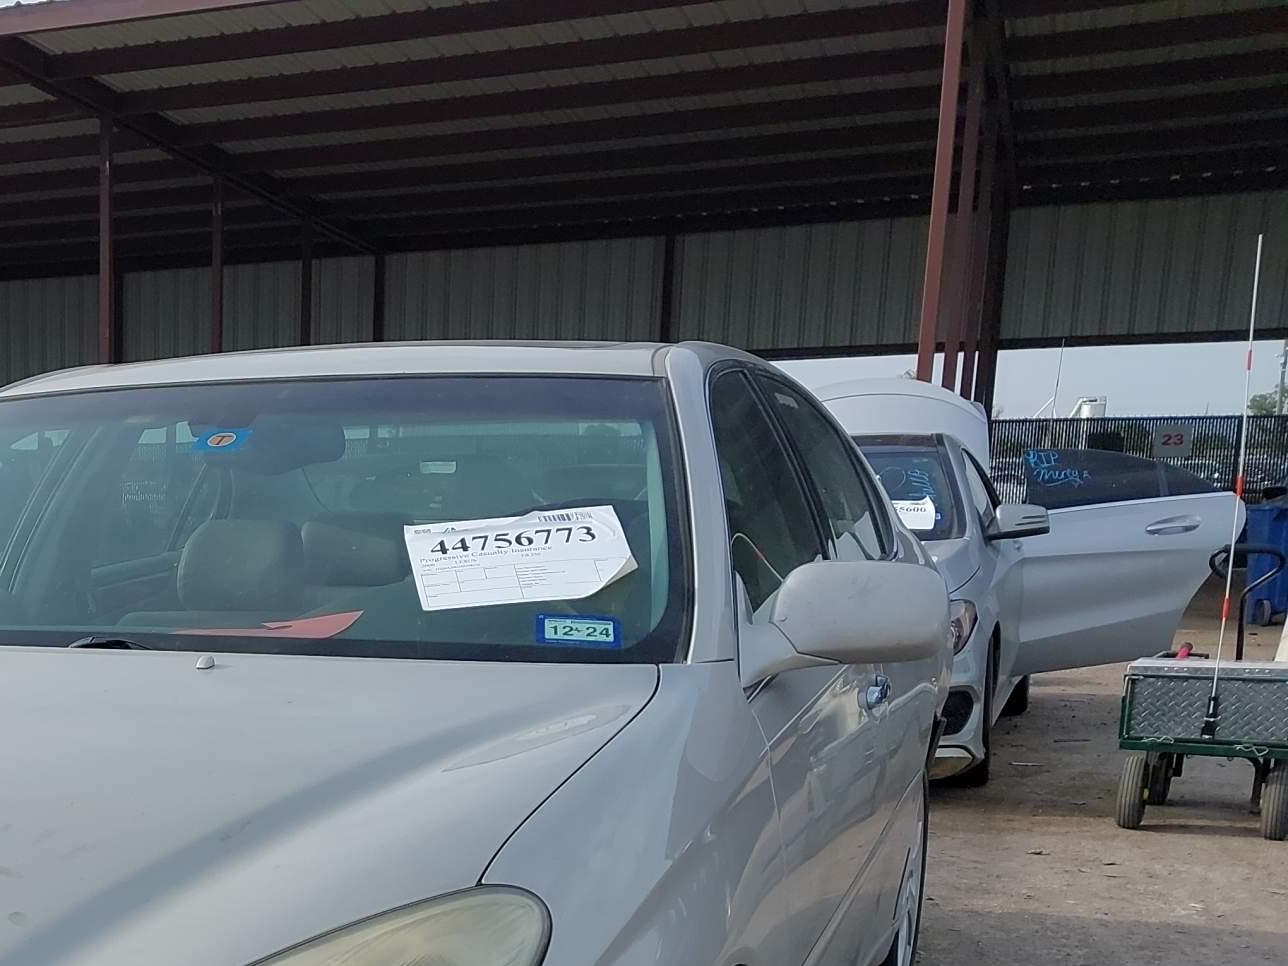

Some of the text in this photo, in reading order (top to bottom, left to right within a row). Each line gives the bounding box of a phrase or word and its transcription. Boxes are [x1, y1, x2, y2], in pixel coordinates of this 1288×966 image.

[1161, 434, 1184, 446] 23
[430, 525, 597, 555] 44756773
[419, 552, 469, 564] Progressive
[471, 549, 508, 557] Casualty
[511, 546, 552, 554] Insurance
